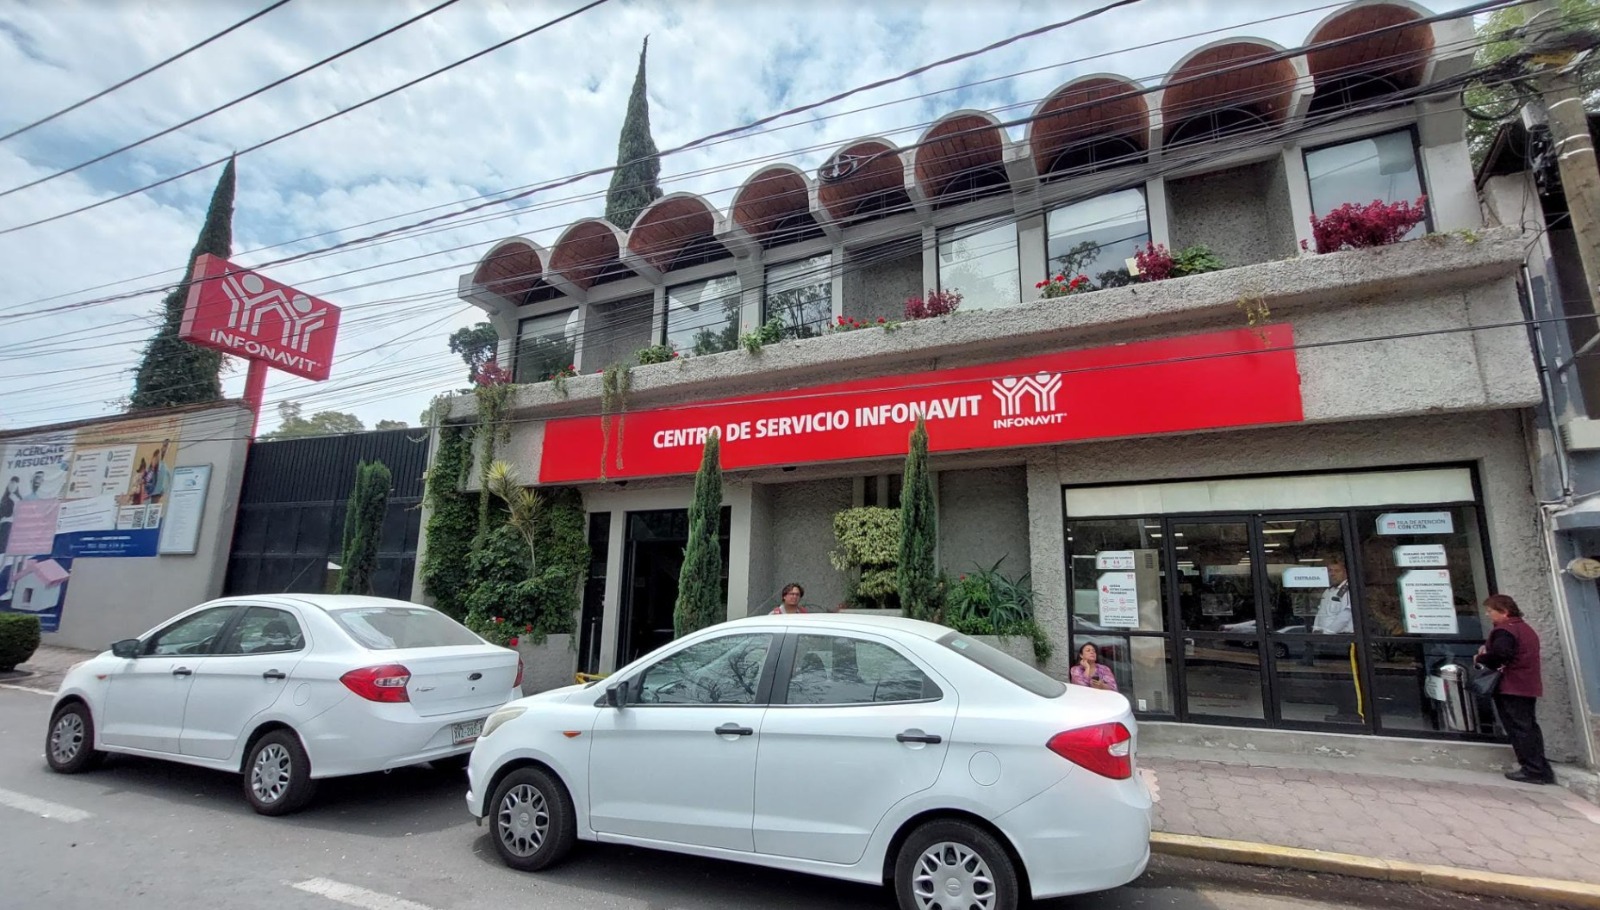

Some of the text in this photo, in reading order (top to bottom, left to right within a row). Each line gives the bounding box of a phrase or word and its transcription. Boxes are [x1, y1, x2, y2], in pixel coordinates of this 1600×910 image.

[210, 328, 316, 372] INFONAVIT
[653, 395, 982, 448] CENTRO DE SERVICIO INFONAVIT
[993, 413, 1064, 430] INFONAVIT
[7, 460, 14, 469] Y
[14, 454, 64, 469] RESUELVE
